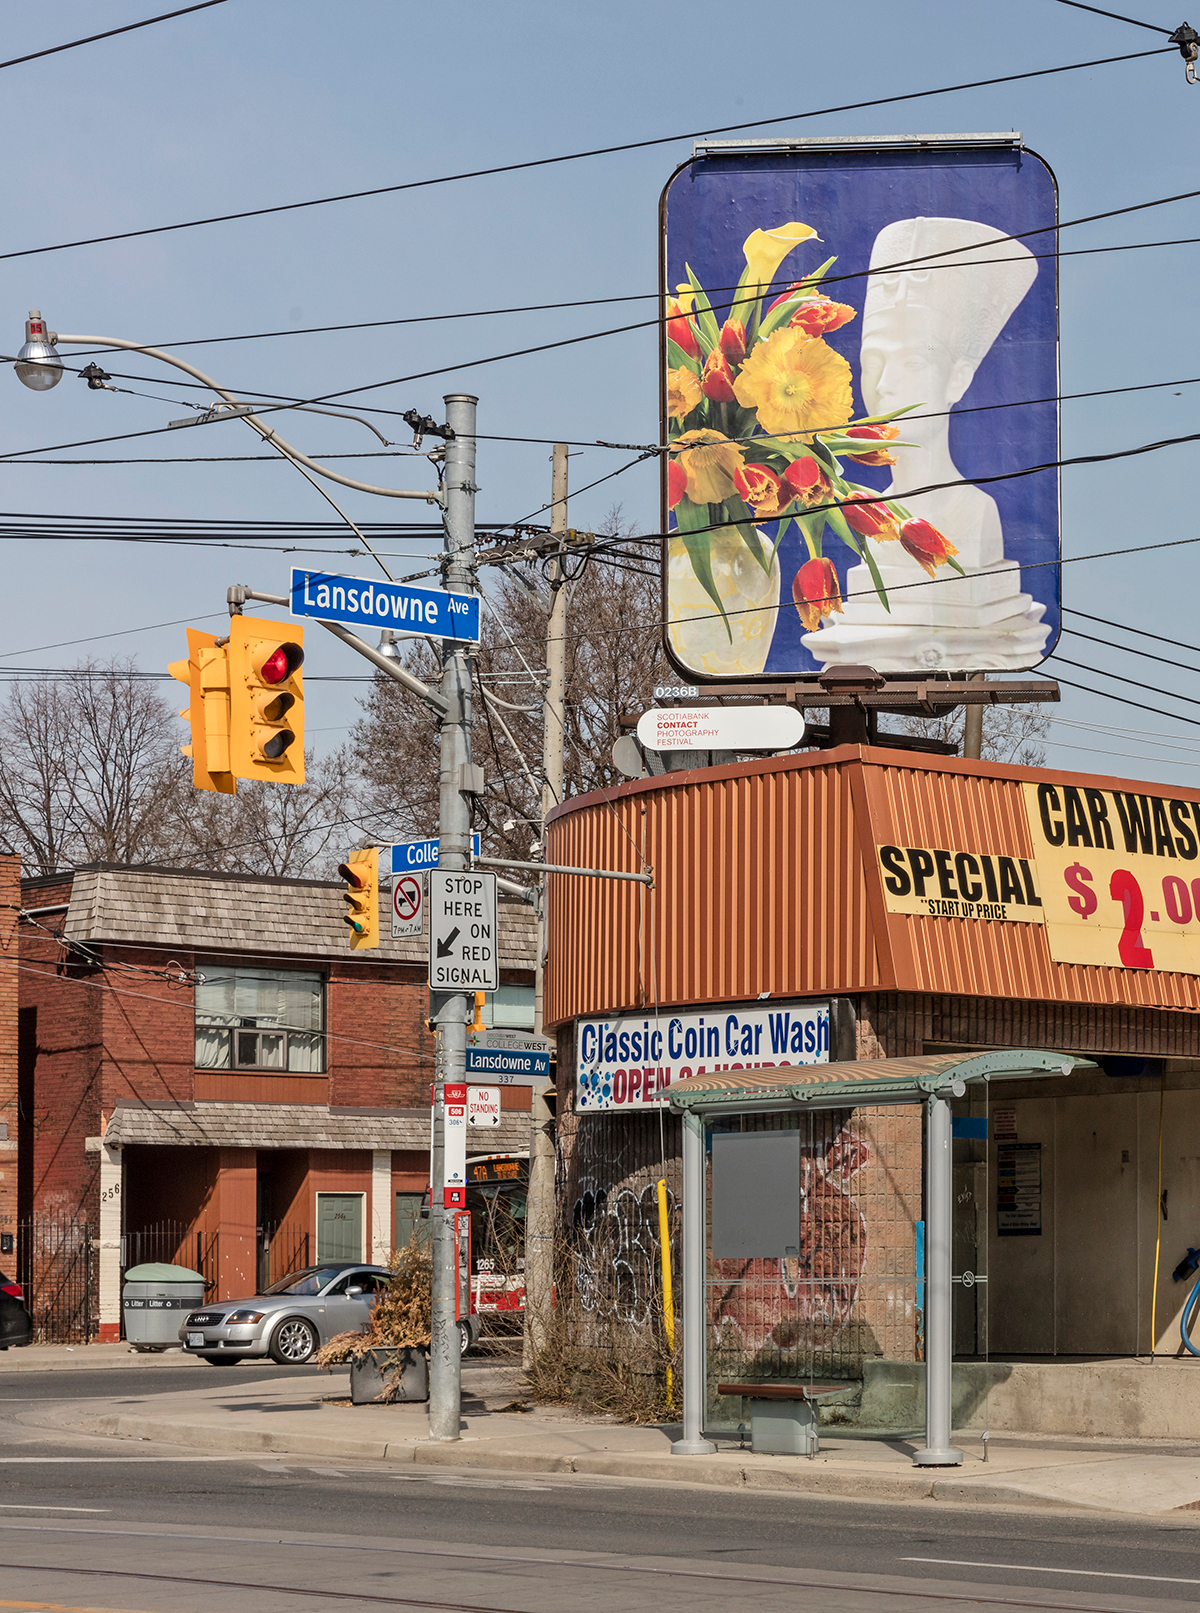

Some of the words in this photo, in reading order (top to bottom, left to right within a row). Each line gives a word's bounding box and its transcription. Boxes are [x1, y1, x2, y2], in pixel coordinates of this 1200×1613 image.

[31, 324, 42, 332] 15
[304, 575, 439, 624] Lansdowne
[447, 598, 470, 615] Ave
[656, 686, 698, 698] 0236B
[656, 713, 710, 721] SCOTIABANK
[656, 721, 698, 729] CONTACT
[656, 730, 720, 738] PHOTOGRAPHY
[656, 738, 694, 746] FESTIVAL
[1037, 783, 1114, 850] CAR
[406, 843, 439, 865] Colle
[880, 844, 1043, 907] SPECIAL
[445, 878, 483, 895] STOP
[444, 900, 483, 918] HERE
[961, 901, 974, 918] UP
[976, 902, 1008, 920] PRICE
[470, 923, 491, 939] ON
[462, 946, 491, 961] RED
[436, 967, 492, 984] SIGNAL
[581, 1021, 663, 1065] Classic
[668, 1017, 720, 1060] Coin
[725, 1014, 762, 1056] Car
[768, 1010, 829, 1055] Wash
[470, 1052, 532, 1071] Lansdowne
[534, 1058, 546, 1072] Av
[498, 1075, 514, 1083] 337
[613, 1066, 671, 1104] OPEN
[478, 1092, 489, 1102] NO
[470, 1104, 498, 1114] STANDING
[473, 1165, 488, 1180] 47A
[102, 1183, 119, 1202] 256
[476, 1258, 495, 1270] 1265
